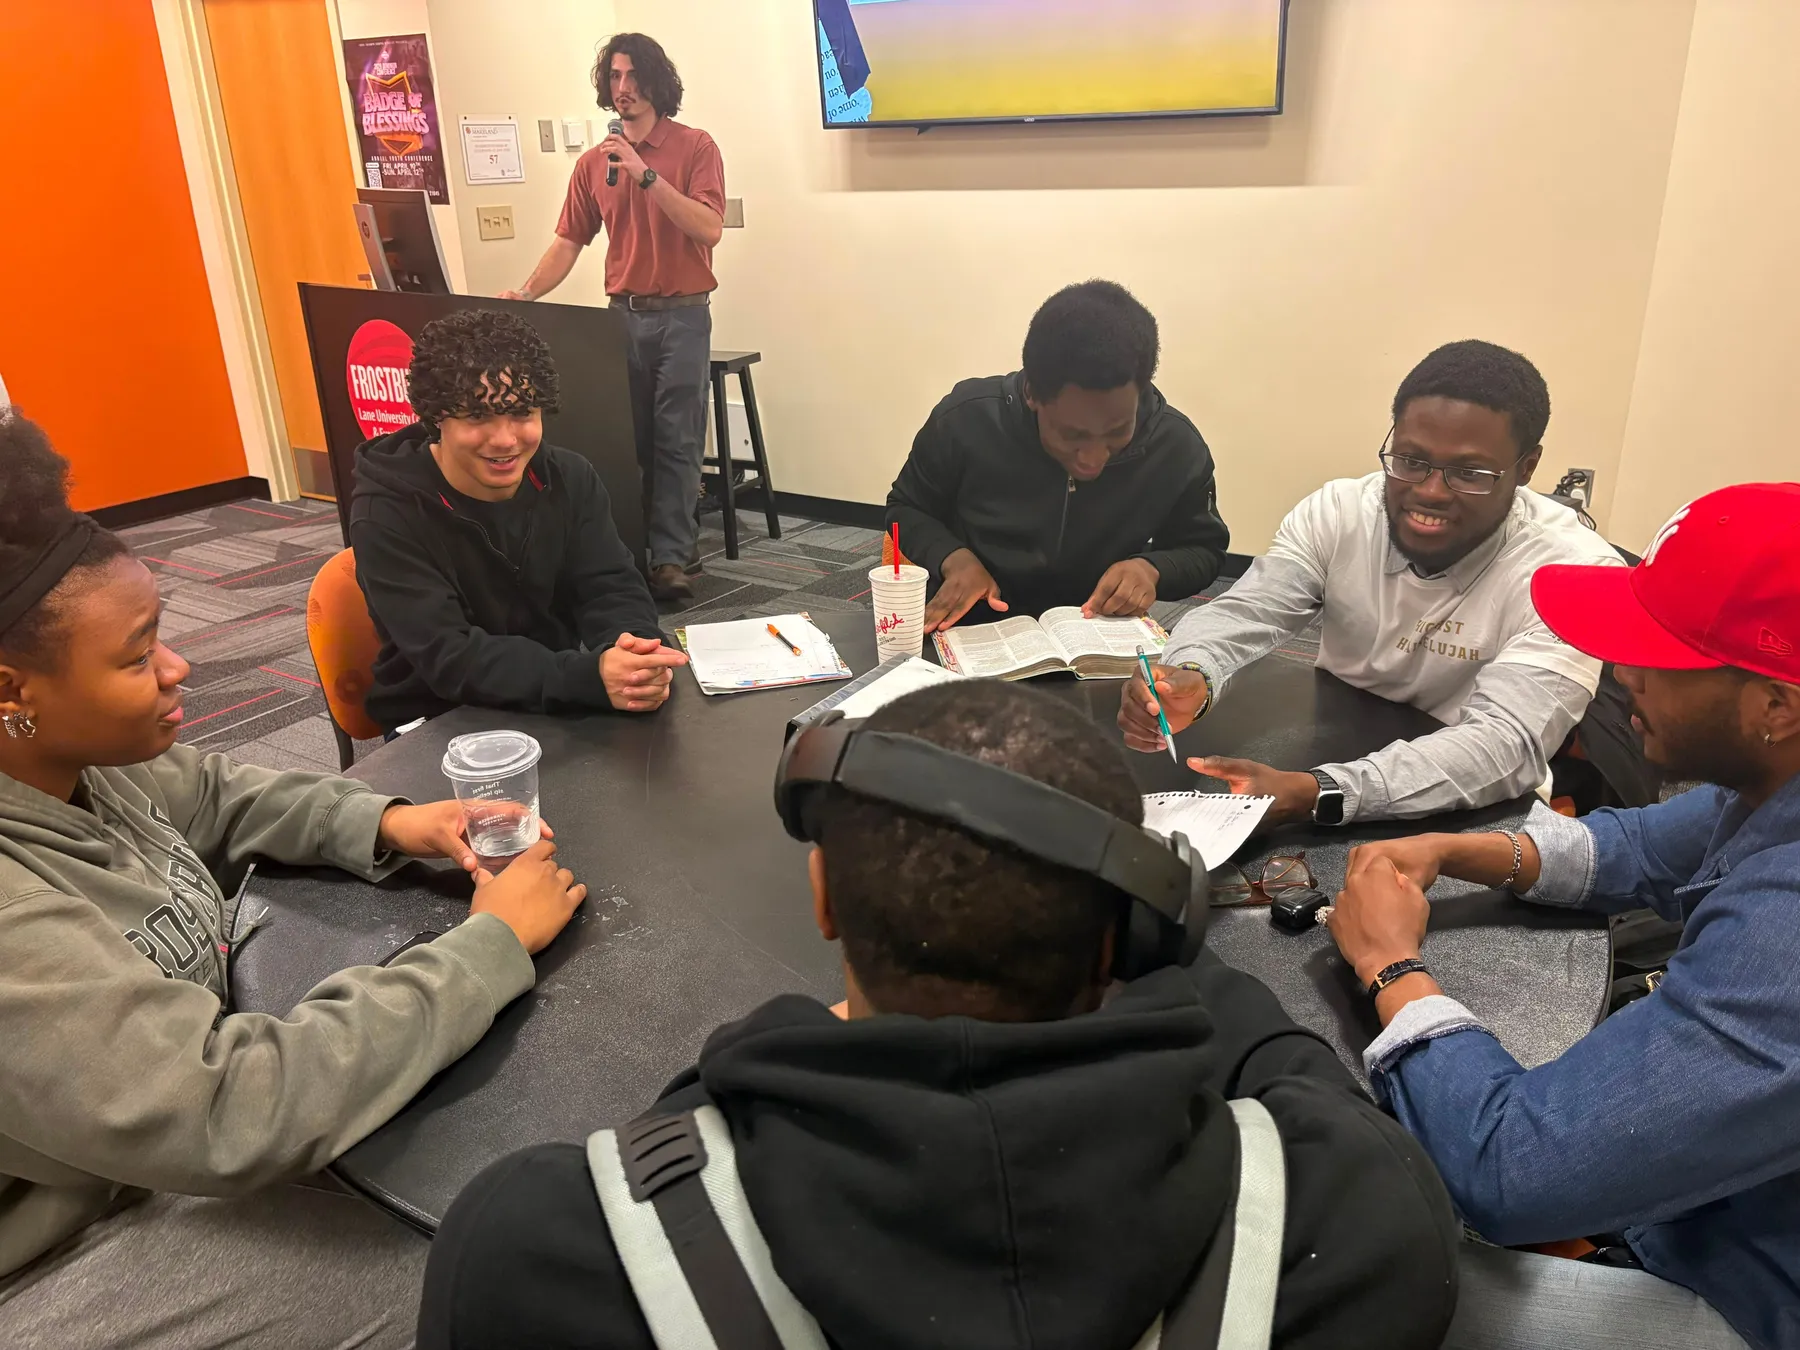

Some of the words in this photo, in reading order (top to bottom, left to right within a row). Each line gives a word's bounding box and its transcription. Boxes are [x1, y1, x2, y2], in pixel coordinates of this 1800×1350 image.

[825, 68, 838, 79] ou
[363, 92, 407, 113] BADGE
[408, 92, 423, 108] OF
[362, 110, 430, 136] BLESSINGS
[489, 154, 498, 164] 57
[349, 364, 412, 404] FROSTBU
[358, 407, 376, 422] Lane
[376, 409, 411, 426] University
